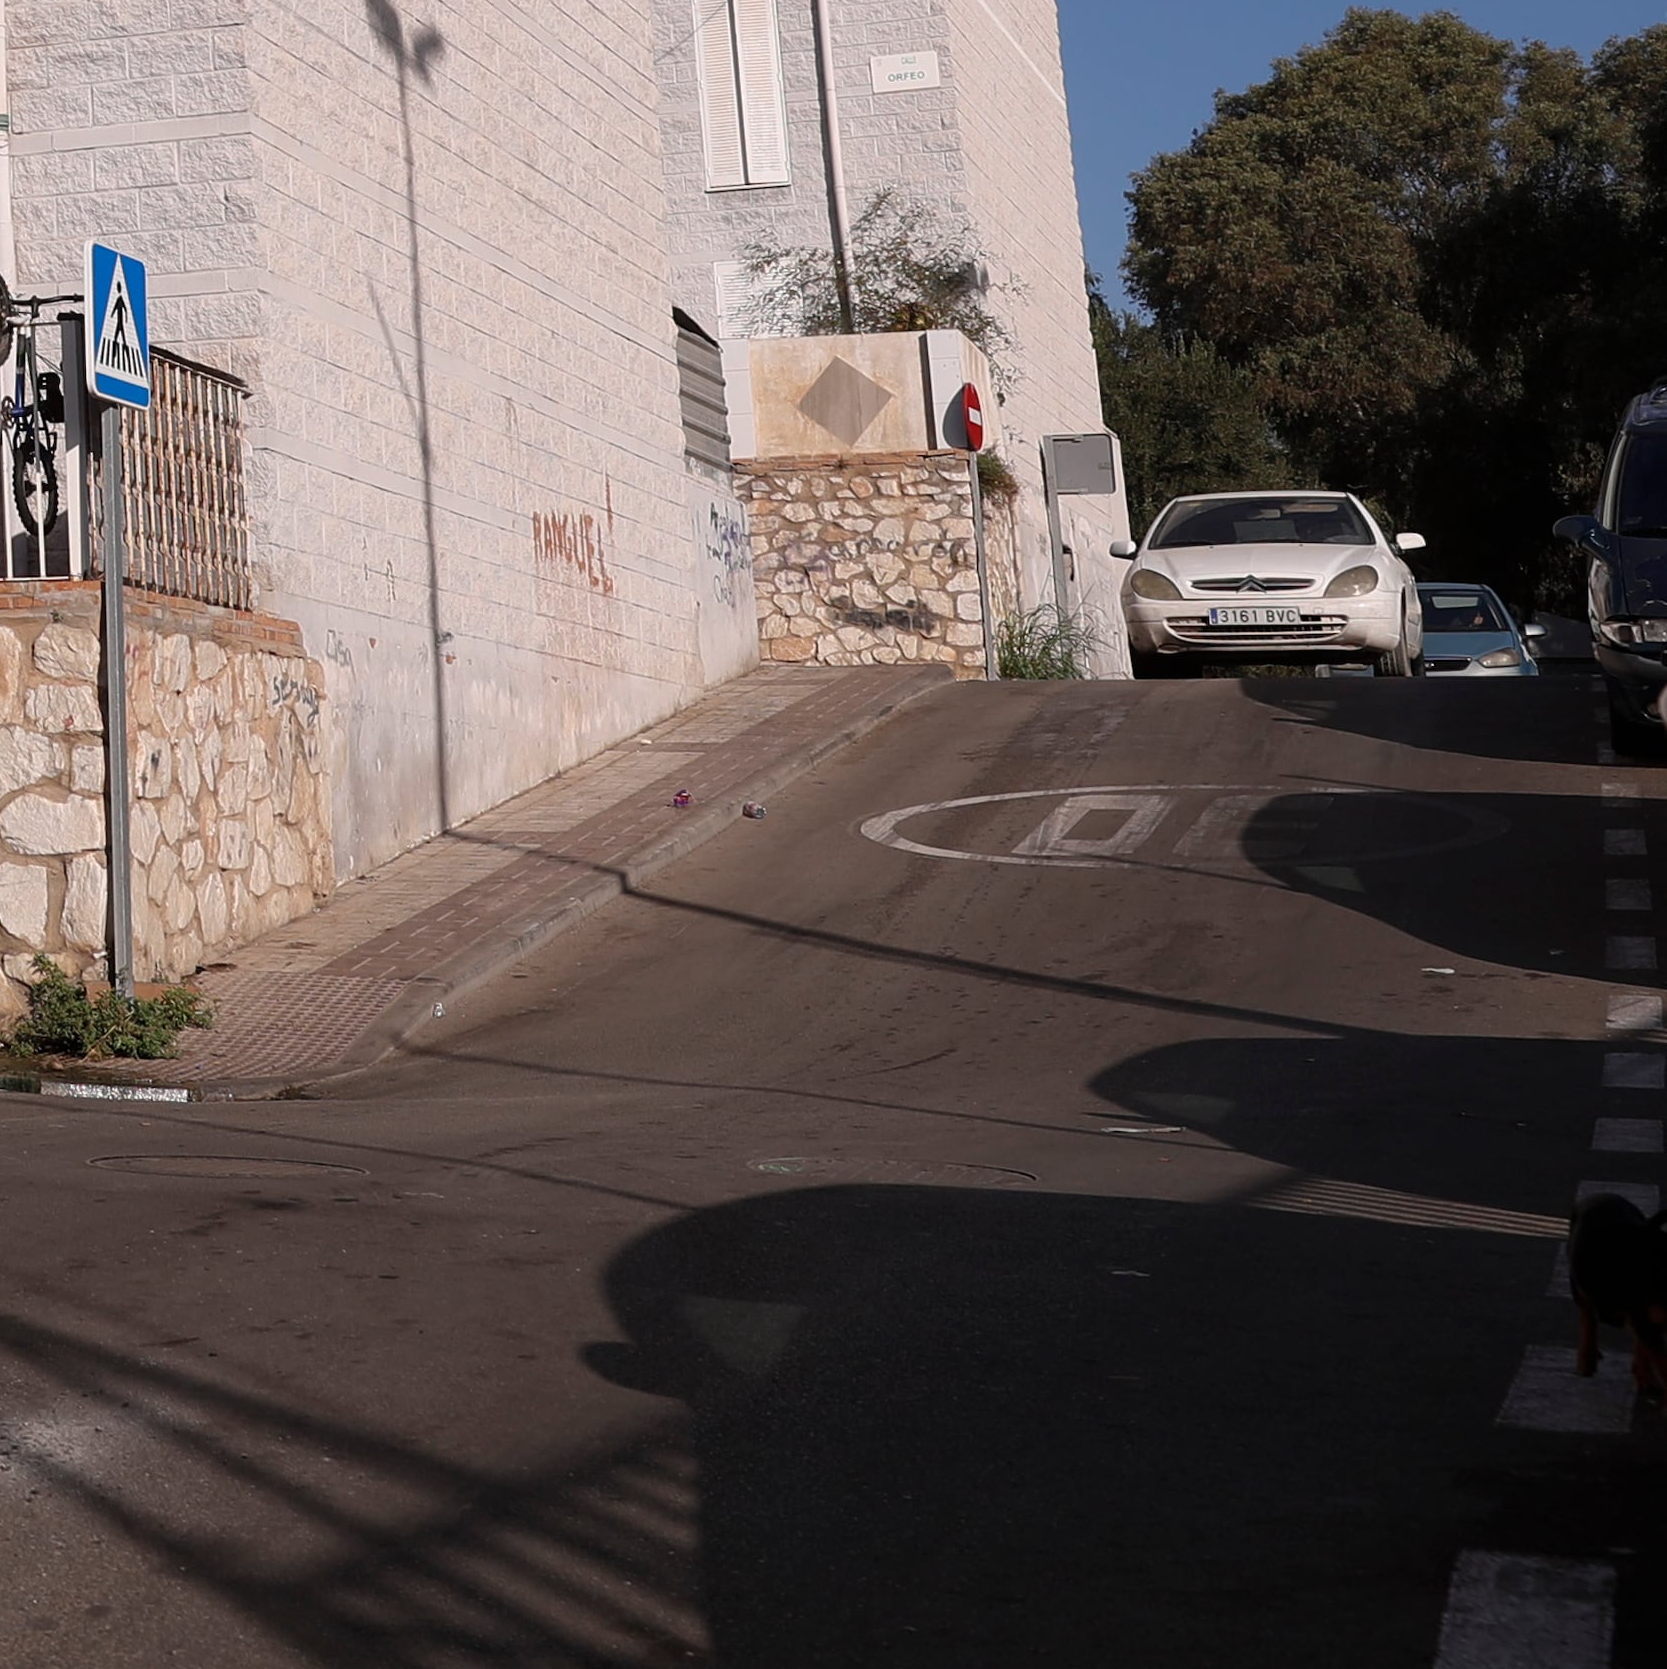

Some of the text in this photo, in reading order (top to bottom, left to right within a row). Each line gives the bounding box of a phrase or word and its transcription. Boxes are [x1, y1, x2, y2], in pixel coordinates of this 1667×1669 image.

[888, 71, 925, 82] ORFEO
[1219, 610, 1297, 623] 3161 BVC
